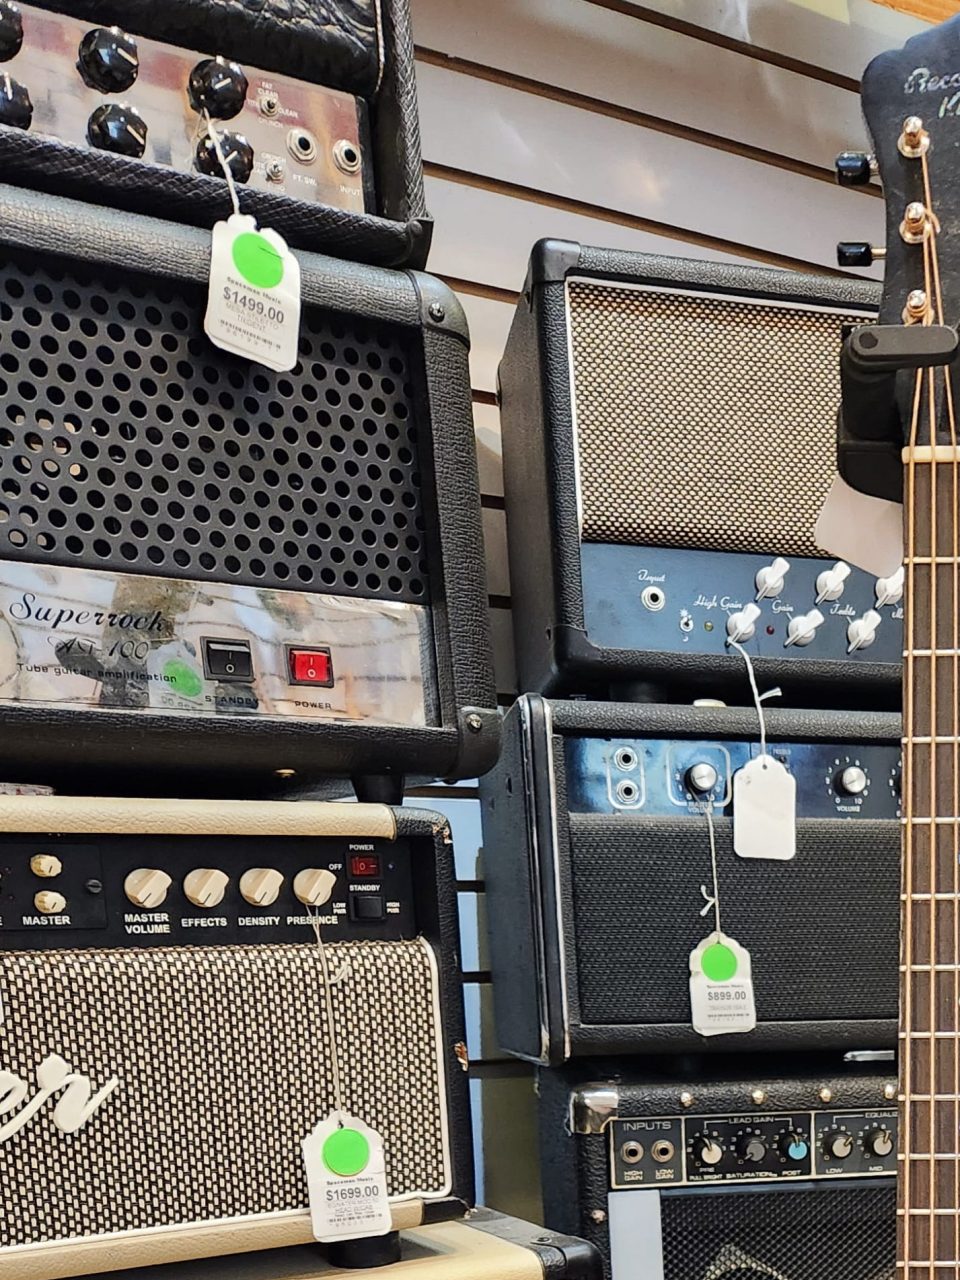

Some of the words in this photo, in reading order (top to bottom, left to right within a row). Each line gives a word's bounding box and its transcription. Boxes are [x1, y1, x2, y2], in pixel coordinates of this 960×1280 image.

[340, 185, 361, 196] INPUT
[223, 286, 285, 324] $1499.00
[693, 595, 718, 609] High
[719, 596, 743, 610] Gain
[771, 599, 795, 614] Gain
[9, 592, 166, 632] Superrock
[17, 662, 49, 674] Tube
[54, 665, 93, 677] guitar
[97, 668, 178, 684] amplification
[294, 700, 332, 710] POWER
[349, 843, 375, 851] POWER
[328, 862, 343, 870] OFF
[349, 884, 381, 892] STANDBY
[22, 915, 71, 926] MASTER
[124, 913, 170, 923] MASTER
[181, 917, 228, 928] EFFECTS
[238, 916, 281, 927] DENSITY
[286, 915, 339, 926] PRESENCE
[124, 924, 171, 935] VOLUME
[707, 990, 747, 1001] $899.00
[728, 1116, 751, 1124] LEAD
[865, 1111, 898, 1119] EQUALIZ
[623, 1121, 672, 1132] INPUTS
[781, 1169, 802, 1177] POST
[825, 1167, 844, 1175] LOW
[326, 1184, 379, 1201] $1699.00
